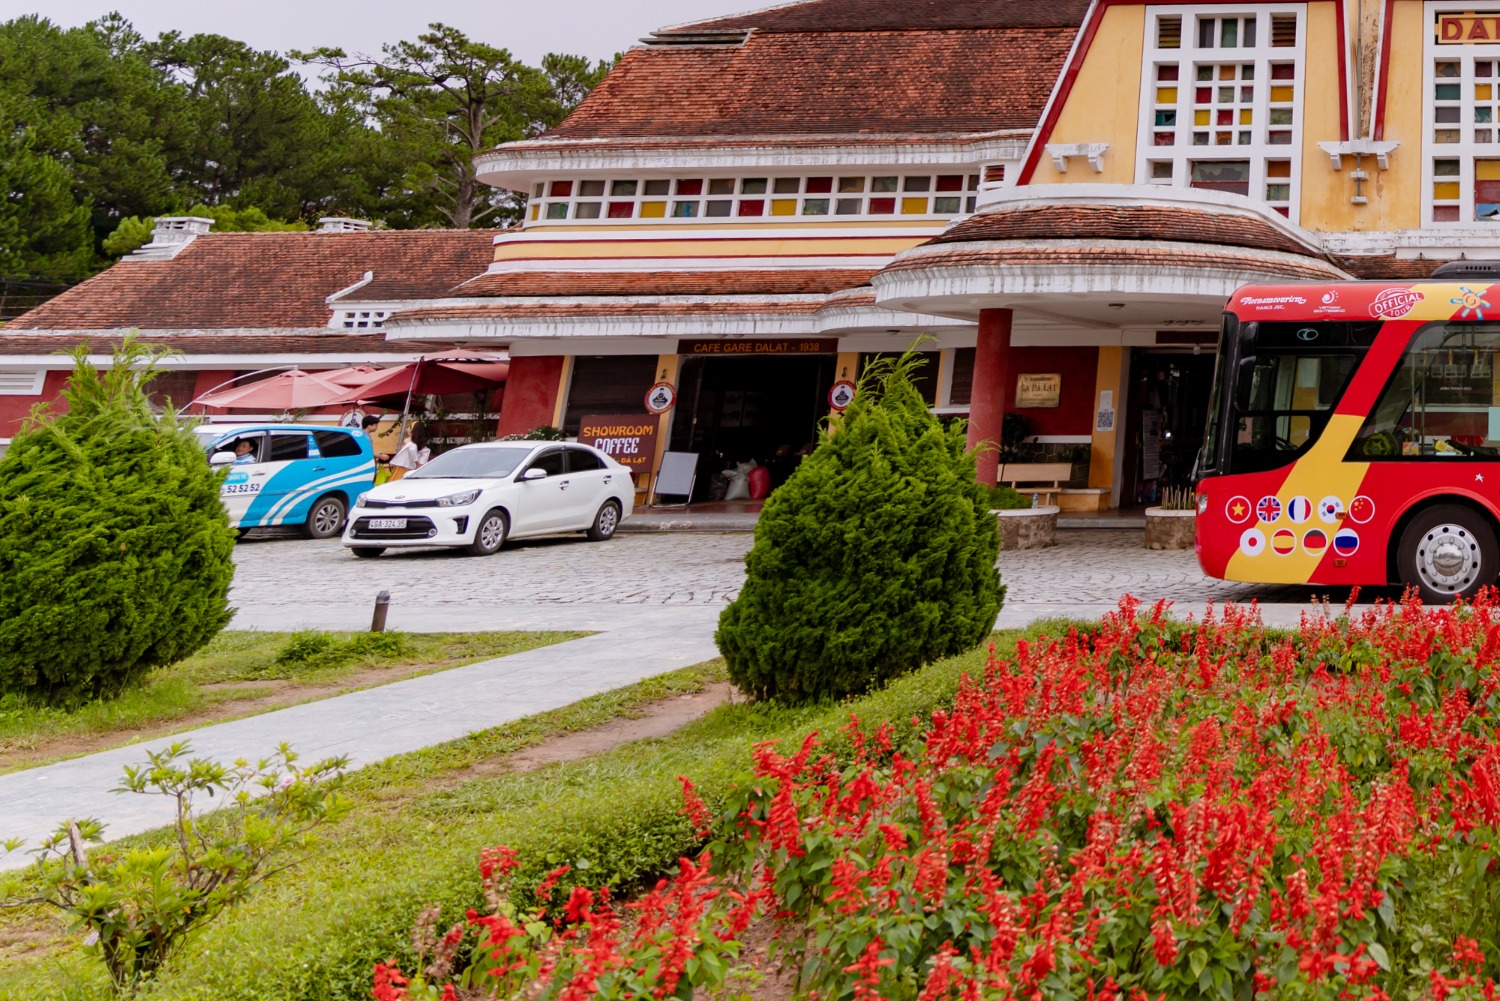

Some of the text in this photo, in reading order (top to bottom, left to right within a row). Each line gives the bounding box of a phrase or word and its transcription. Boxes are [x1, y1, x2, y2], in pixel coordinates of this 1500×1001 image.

[1374, 292, 1421, 313] OFFICIAL
[1390, 304, 1411, 316] TOUR
[694, 341, 720, 352] CAFÉ
[723, 343, 752, 352] GARE
[755, 343, 789, 352] DALAT
[799, 342, 820, 352] 1938
[583, 425, 653, 437] SHOWROOM
[594, 437, 640, 454] COFFEE
[227, 483, 260, 493] 52 52 52
